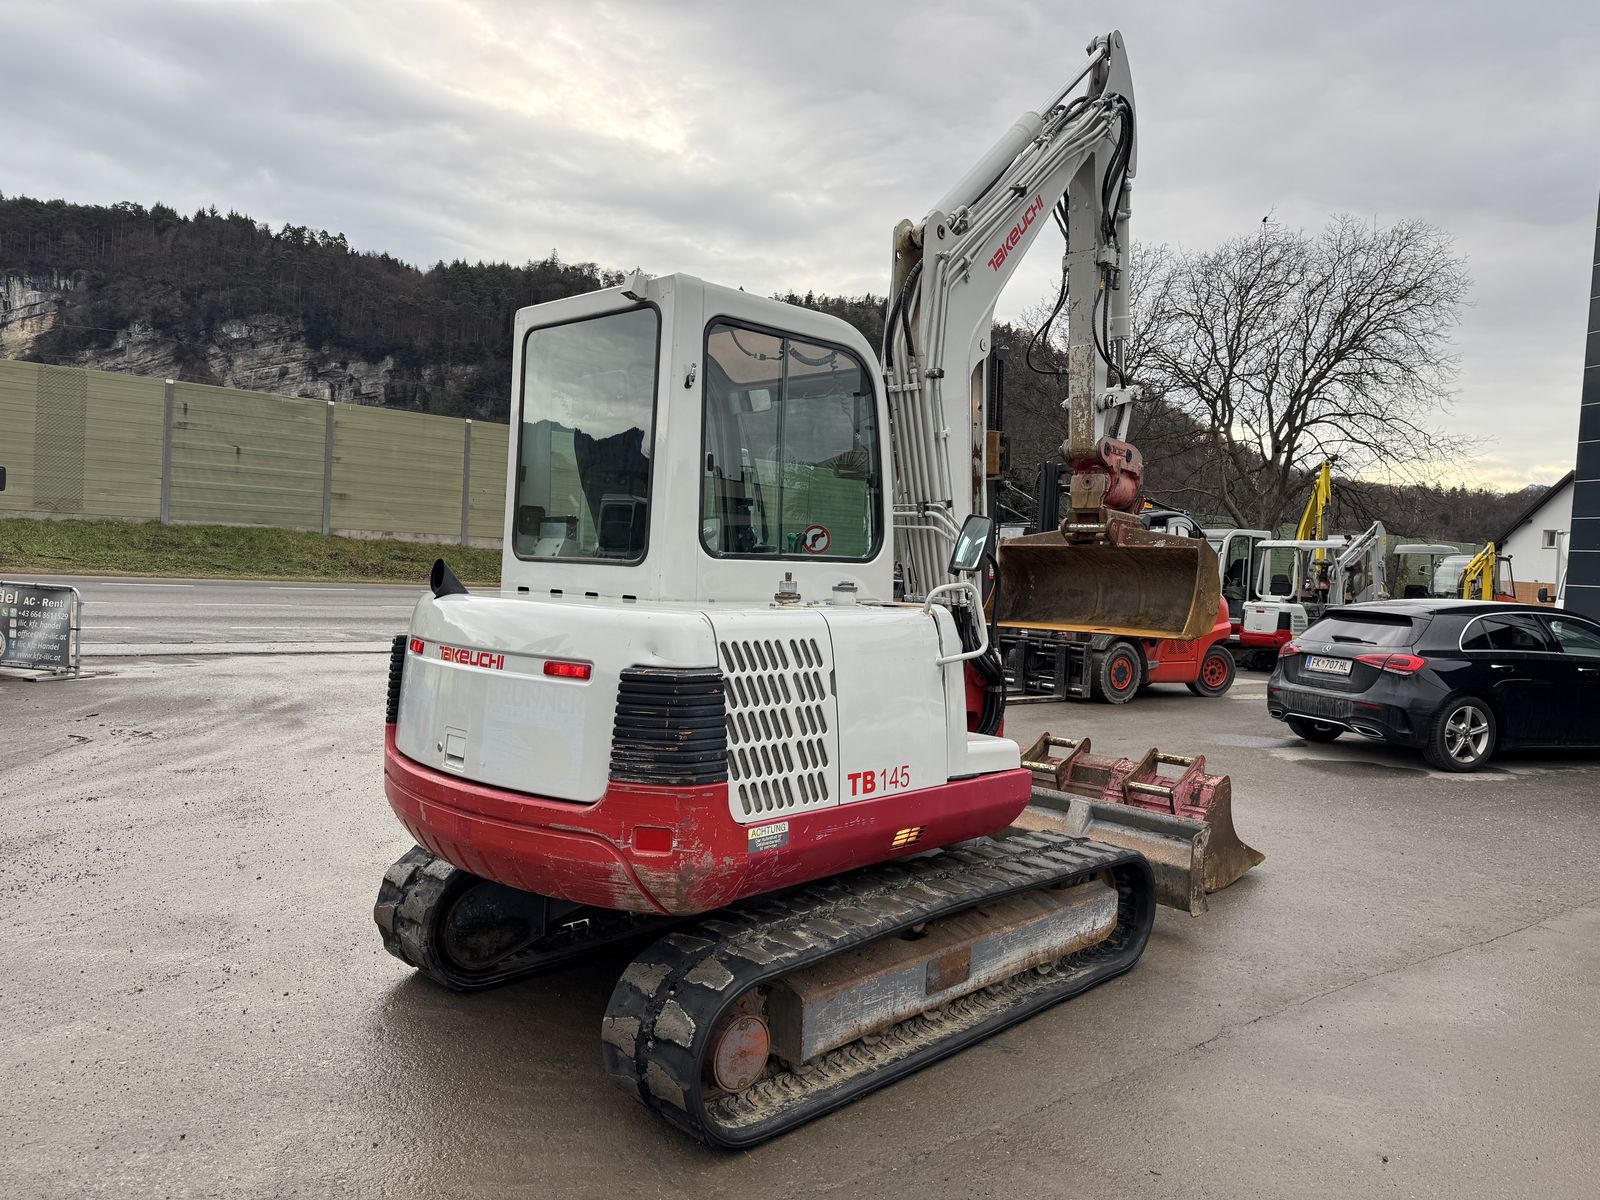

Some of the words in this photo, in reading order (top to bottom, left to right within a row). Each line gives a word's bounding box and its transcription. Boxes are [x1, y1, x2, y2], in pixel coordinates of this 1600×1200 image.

[23, 597, 36, 605] AC
[42, 598, 64, 608] Rent
[1312, 658, 1321, 667] FK
[847, 770, 877, 797] TB
[880, 764, 910, 791] 145
[751, 823, 786, 838] ACHTUNG
